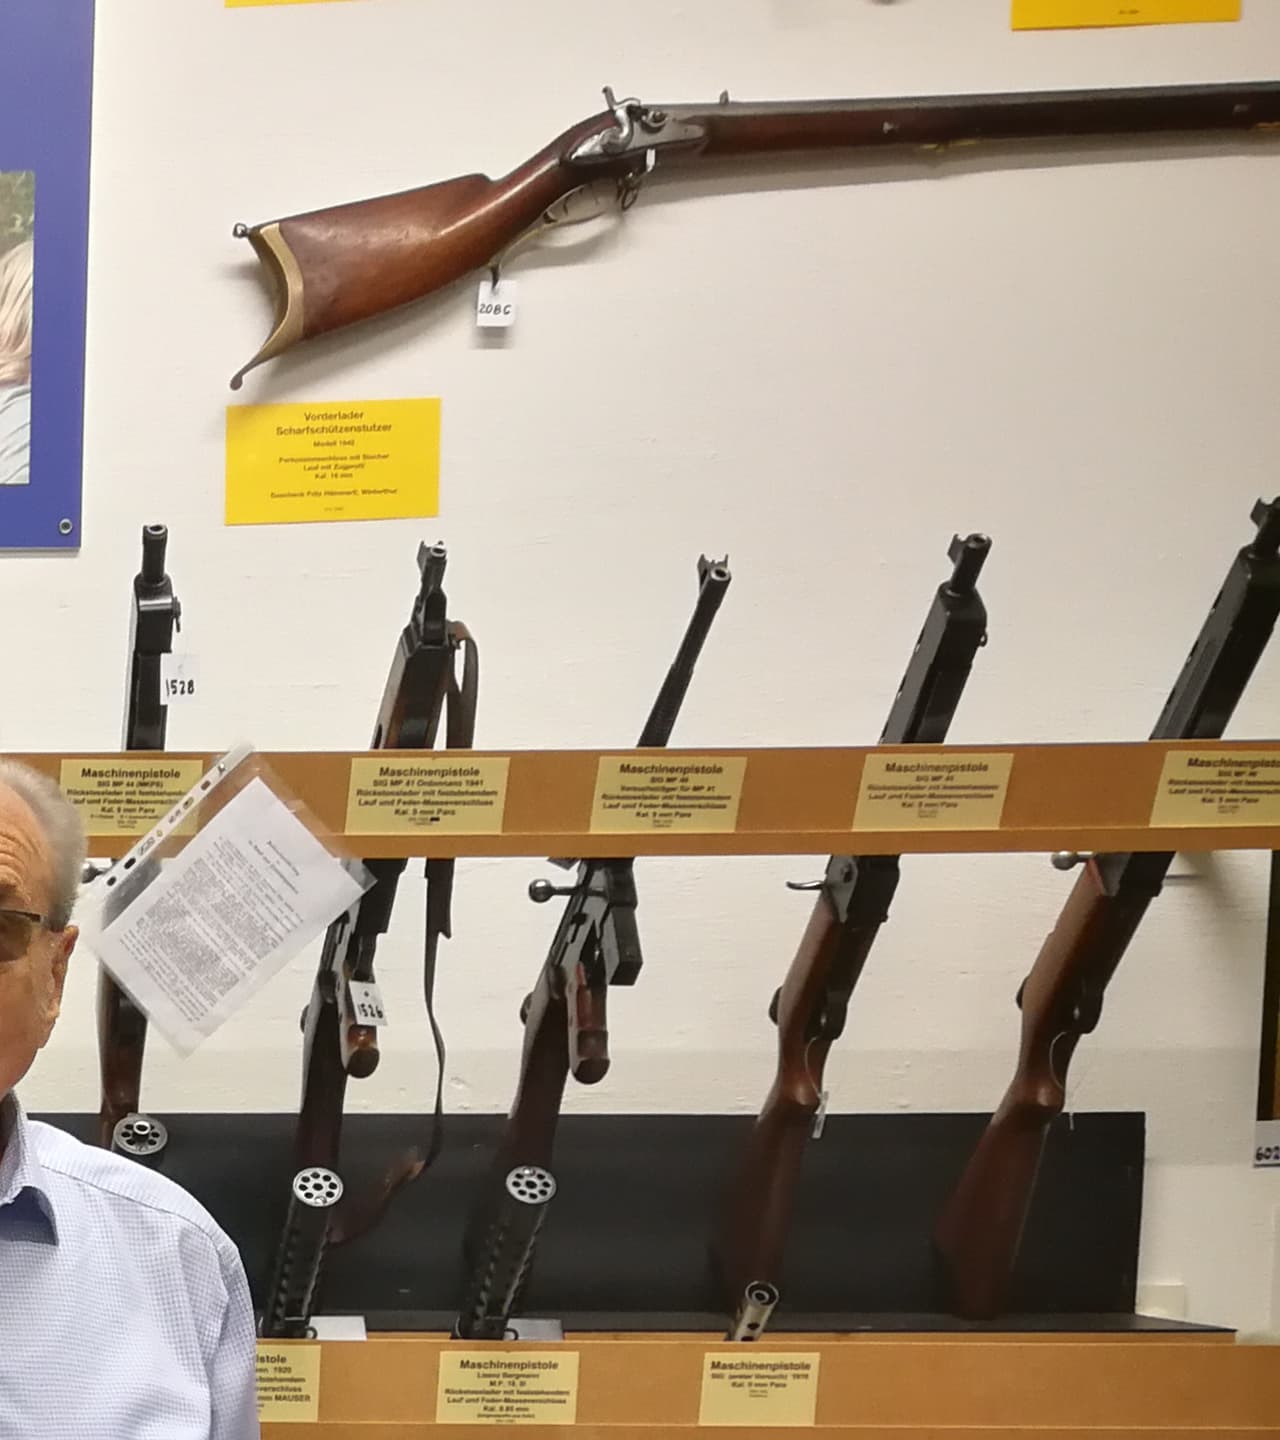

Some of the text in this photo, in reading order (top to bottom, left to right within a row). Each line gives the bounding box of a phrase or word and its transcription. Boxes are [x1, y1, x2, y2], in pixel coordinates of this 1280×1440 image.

[304, 411, 364, 421] Vorderlader
[276, 424, 391, 436] Scharfschützenstutzer
[165, 678, 195, 696] 1528
[81, 768, 180, 779] Maschinenpistole
[379, 767, 480, 778] Maschinenpistole
[619, 763, 723, 775] Maschinenpistole
[885, 763, 988, 774] Maschinenpistole
[460, 1360, 559, 1370] Maschinenpistole
[711, 1361, 810, 1371] Maschinenpistole
